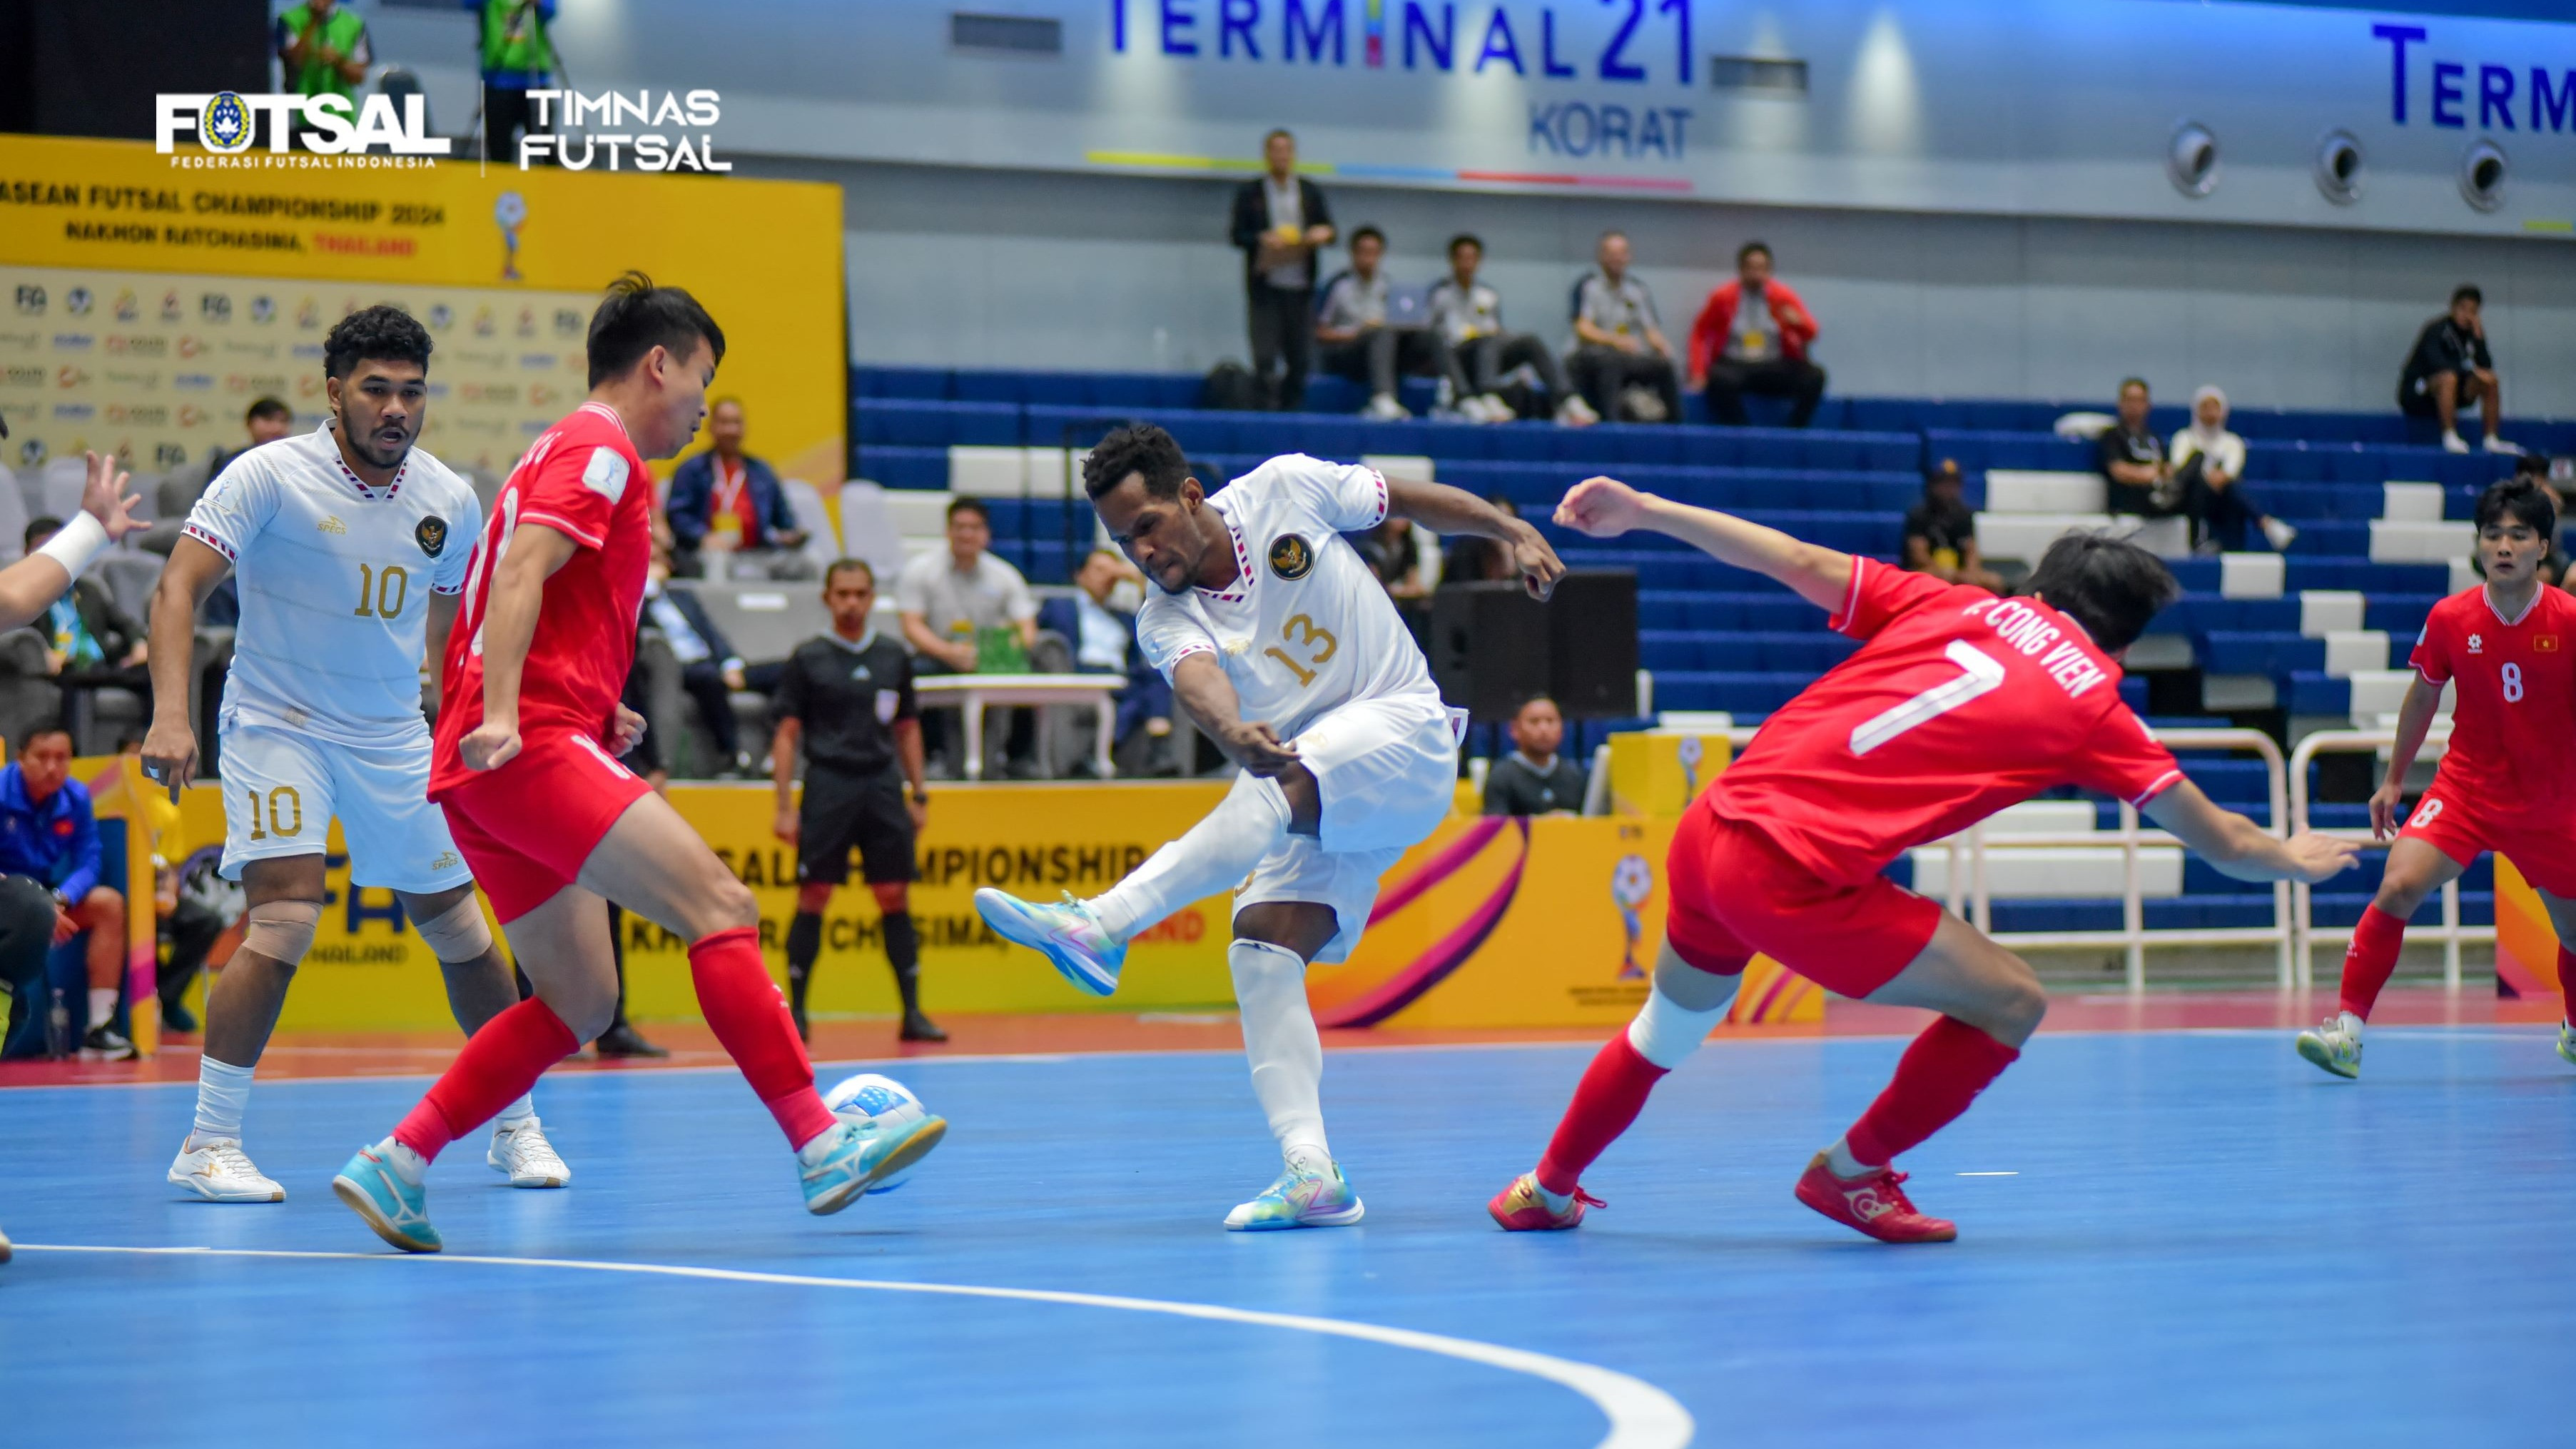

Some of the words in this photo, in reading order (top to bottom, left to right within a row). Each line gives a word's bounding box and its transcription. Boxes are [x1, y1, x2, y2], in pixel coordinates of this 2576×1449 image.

[1527, 102, 1693, 160] KORAT
[66, 221, 156, 242] NAKHON
[89, 184, 185, 213] FUTSAL
[193, 191, 382, 223] CHAMPIONSHIP
[317, 522, 347, 535] SPECS
[355, 563, 407, 619] 10
[1264, 614, 1337, 688] 13
[1985, 600, 2061, 656] CONG
[2039, 640, 2107, 698] VIEN
[1850, 638, 2004, 757] 7
[2501, 662, 2523, 702] 8
[248, 786, 302, 842] 10
[2410, 798, 2443, 829] 8
